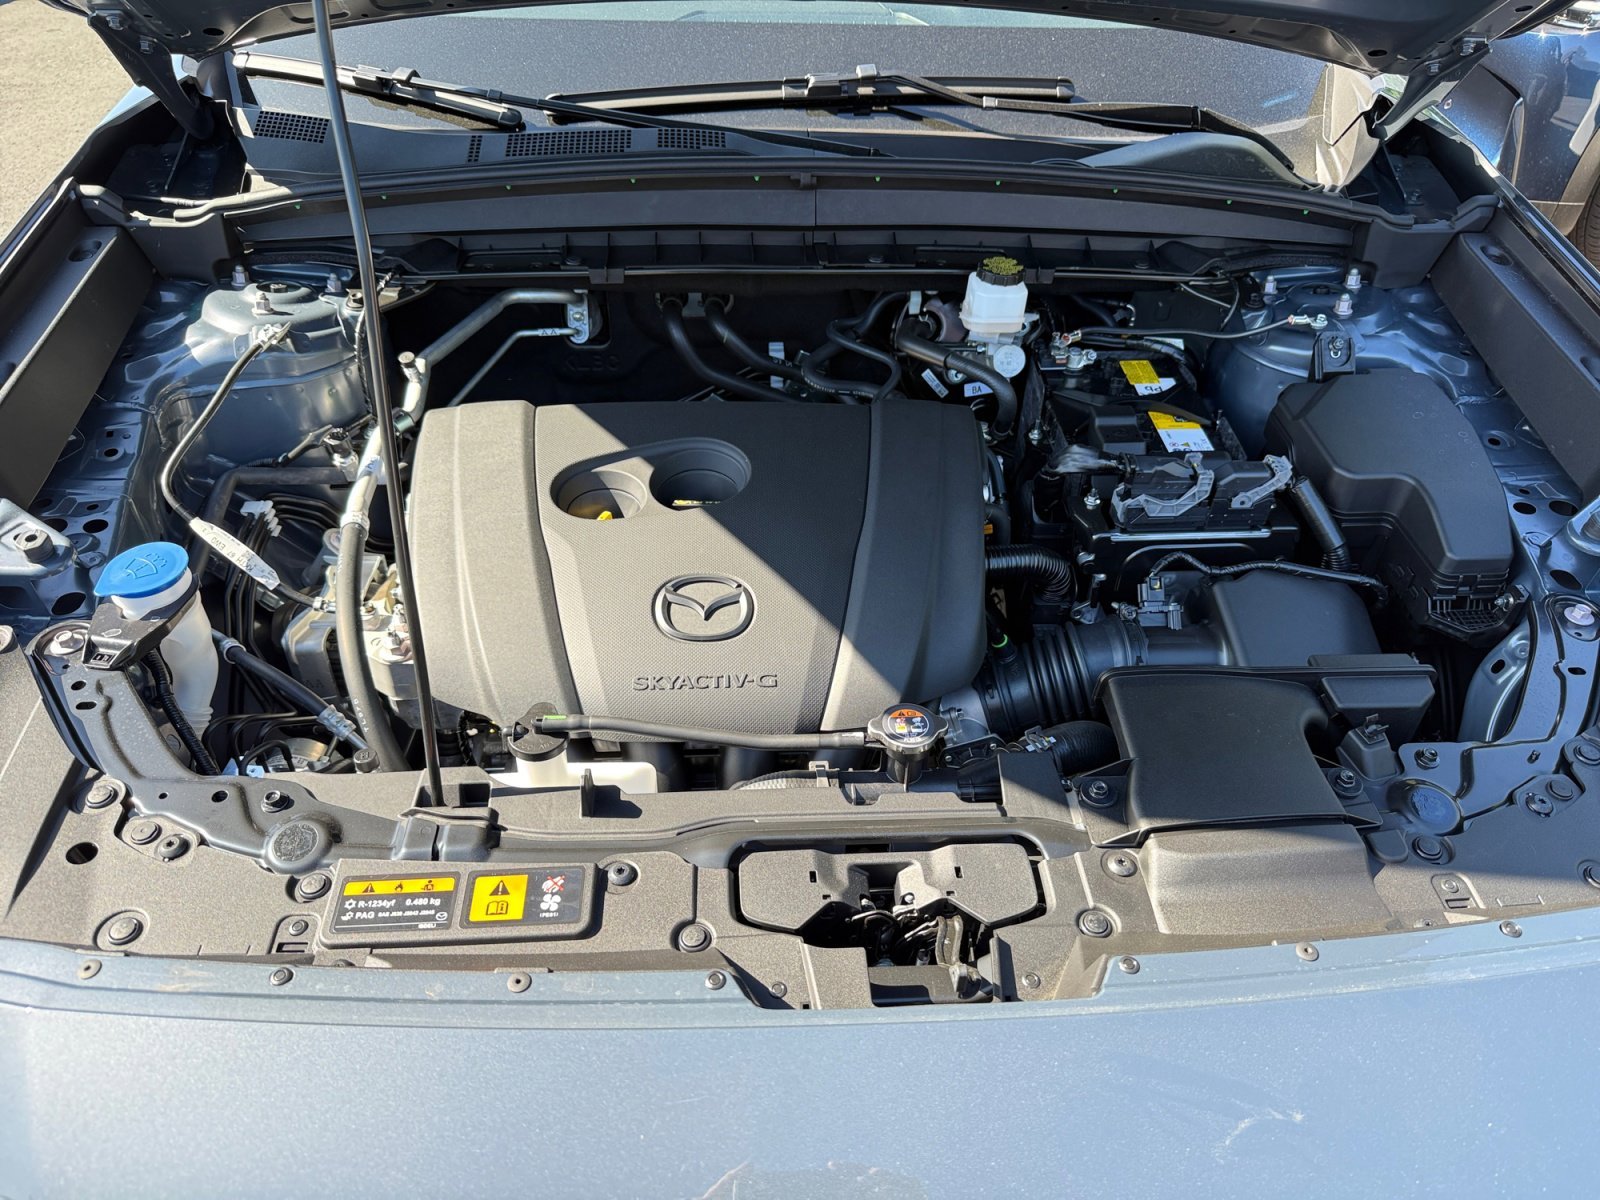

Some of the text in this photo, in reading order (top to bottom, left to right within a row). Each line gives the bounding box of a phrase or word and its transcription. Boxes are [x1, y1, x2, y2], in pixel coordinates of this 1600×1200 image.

[971, 385, 982, 395] BA
[633, 673, 779, 693] SKYACTIV-G
[357, 897, 442, 909] R-1234yf 0.480 kg
[354, 911, 376, 920] PAG
